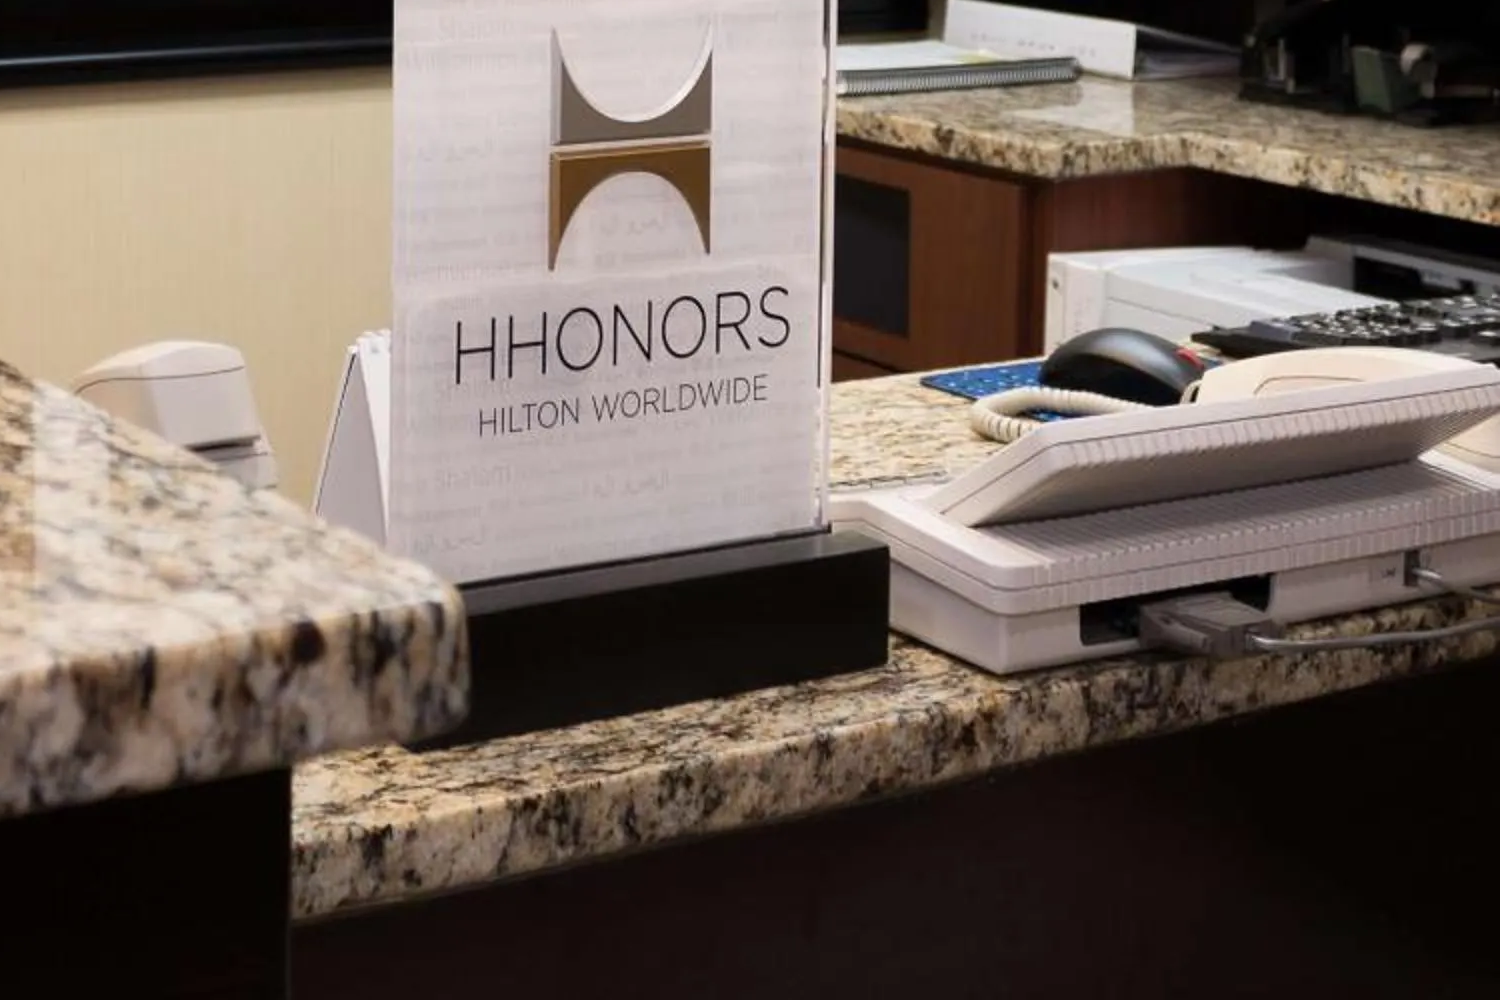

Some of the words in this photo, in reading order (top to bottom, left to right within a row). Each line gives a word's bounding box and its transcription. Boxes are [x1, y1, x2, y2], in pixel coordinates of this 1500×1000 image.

[455, 286, 791, 384] HHONORS
[478, 396, 581, 437] HILTON
[590, 373, 768, 421] WORLDWIDE
